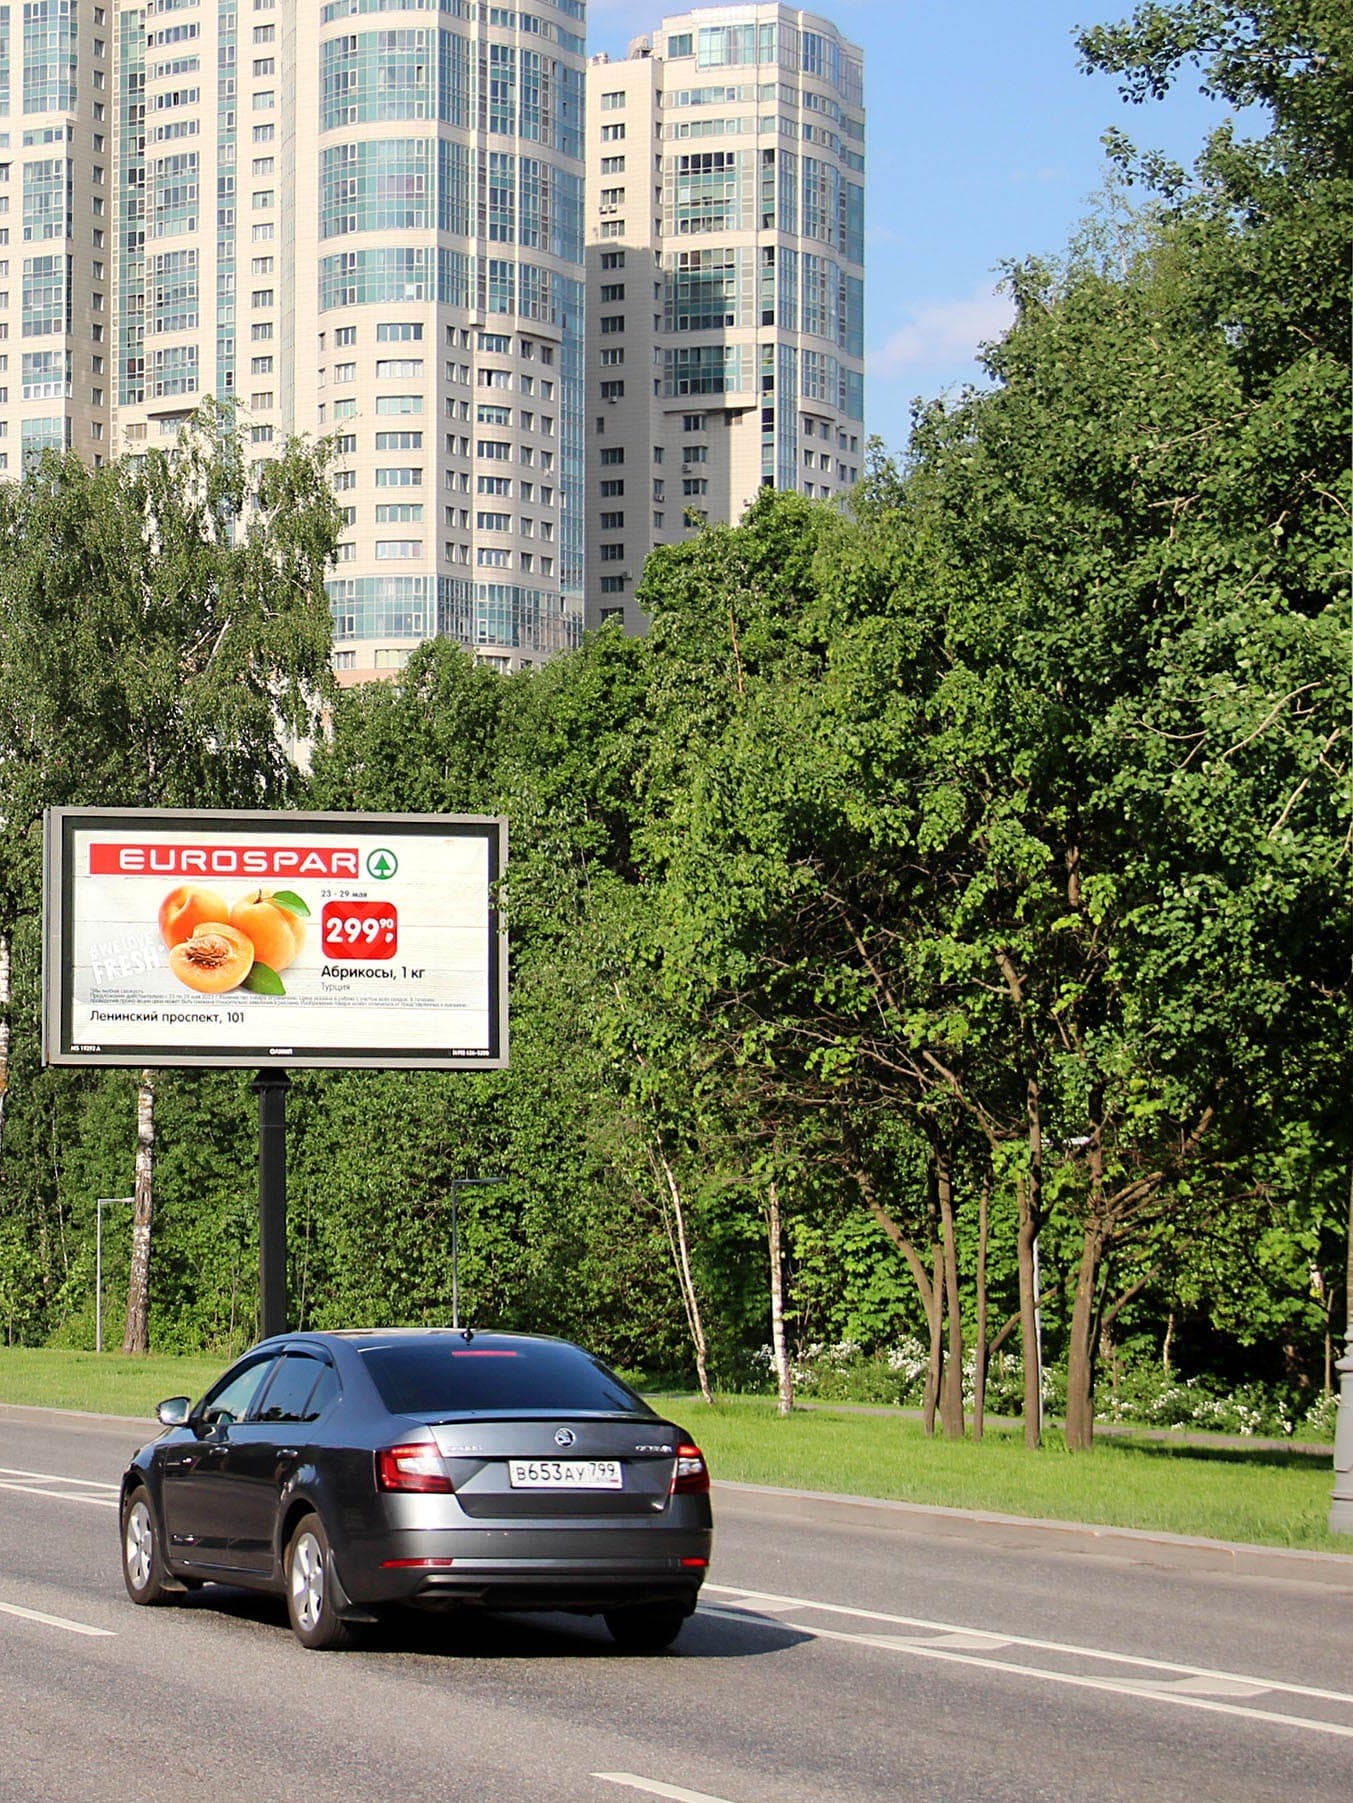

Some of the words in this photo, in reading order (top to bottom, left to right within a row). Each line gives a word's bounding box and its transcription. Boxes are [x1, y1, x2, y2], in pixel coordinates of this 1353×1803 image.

[119, 848, 358, 874] EUROSPAR
[321, 889, 332, 898] 23
[339, 890, 350, 898] 29
[326, 917, 380, 943] 299
[321, 965, 397, 981] Абрикосы,
[402, 966, 407, 979] 1
[411, 969, 426, 979] кг
[321, 982, 351, 992] Турция
[90, 1010, 158, 1023] Ленинский
[162, 1013, 223, 1024] проспект,
[227, 1012, 245, 1023] 101
[516, 1462, 585, 1481] В653АУ
[588, 1462, 616, 1477] 799
